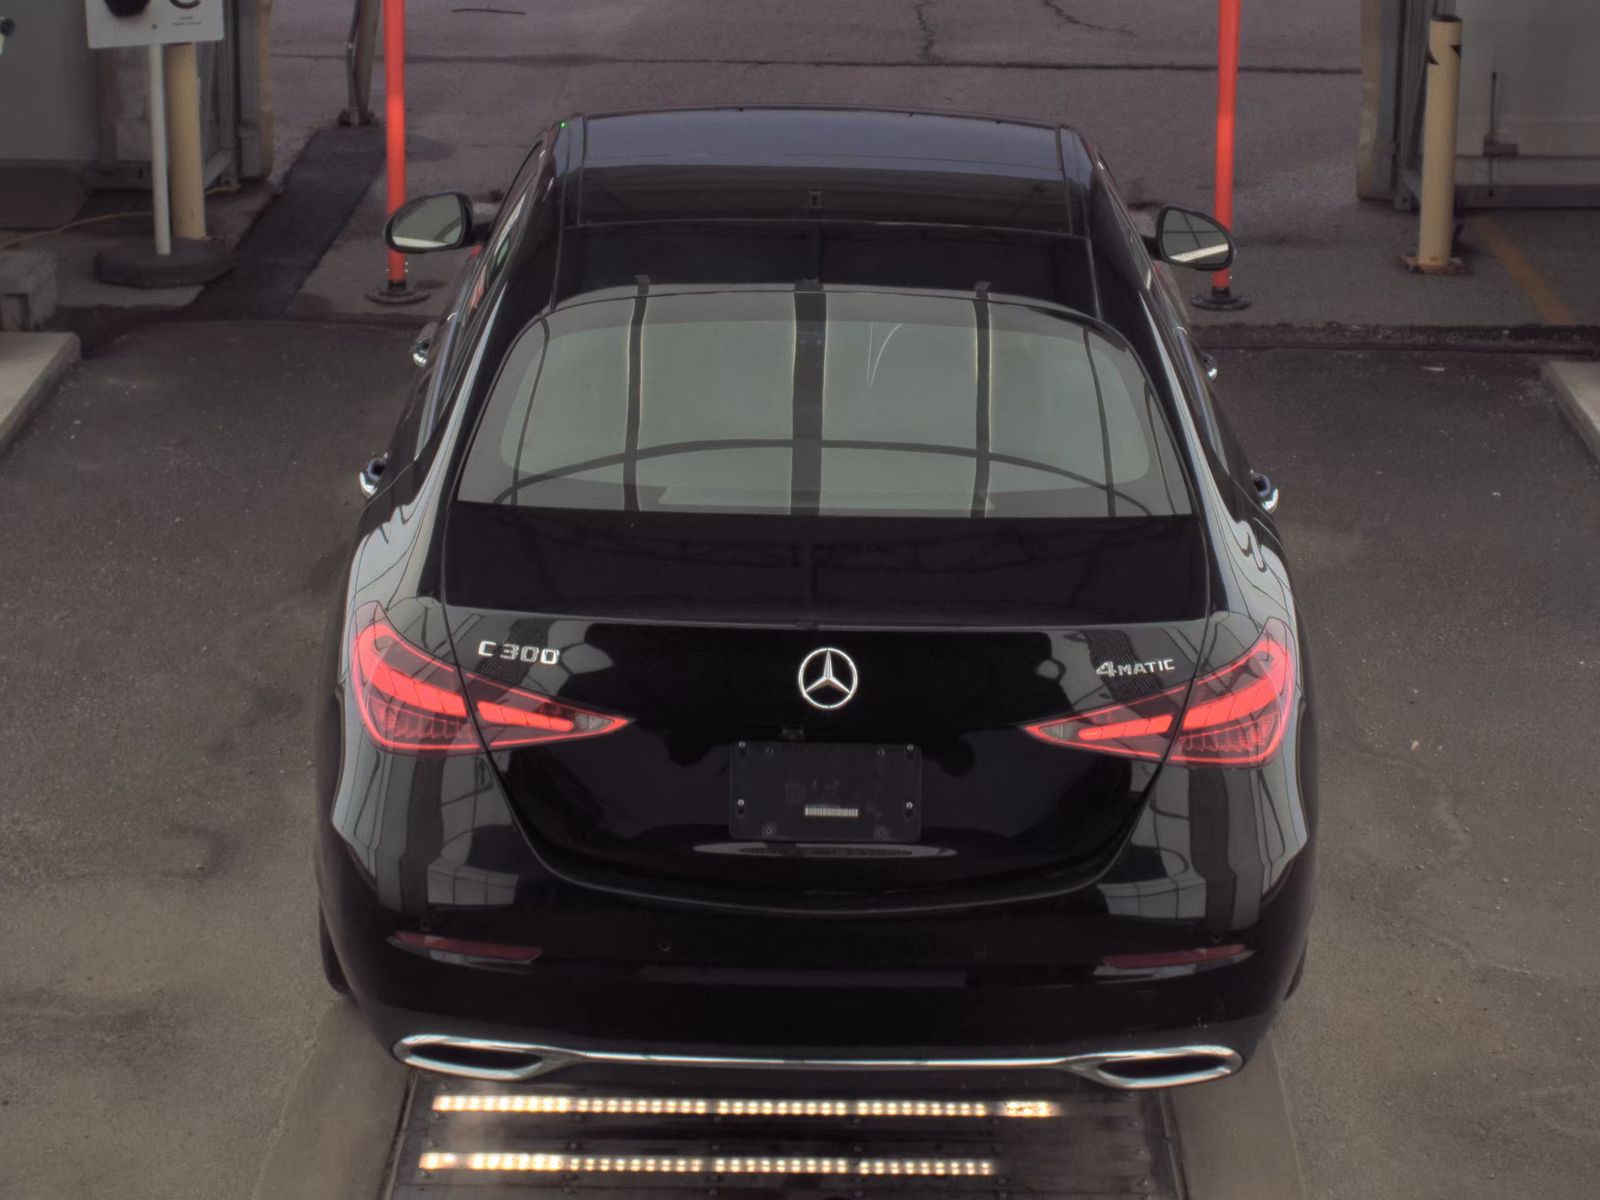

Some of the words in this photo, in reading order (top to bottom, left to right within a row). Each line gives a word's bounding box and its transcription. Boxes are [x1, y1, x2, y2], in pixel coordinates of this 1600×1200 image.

[478, 640, 497, 657] C
[500, 643, 560, 665] 300
[1096, 659, 1175, 677] 4MATIC
